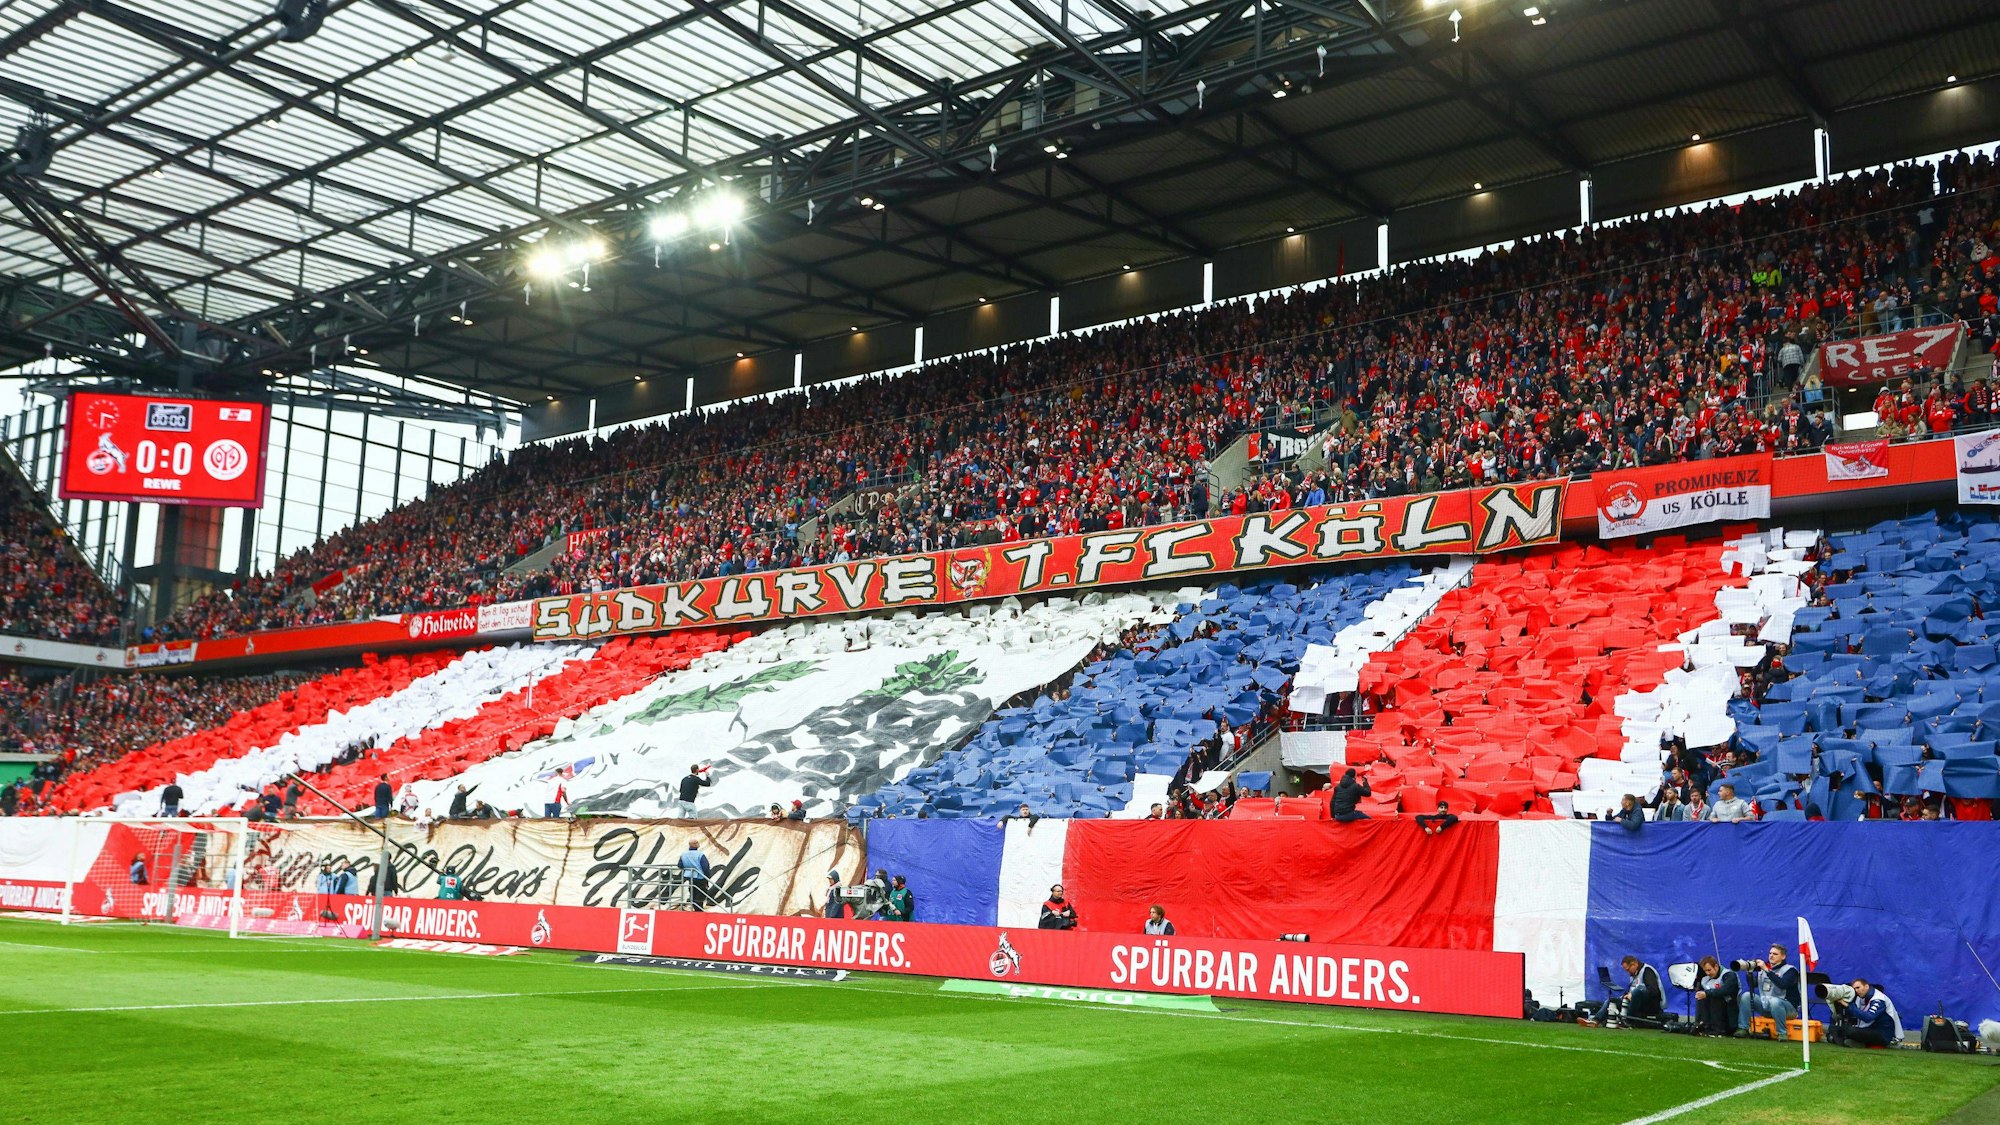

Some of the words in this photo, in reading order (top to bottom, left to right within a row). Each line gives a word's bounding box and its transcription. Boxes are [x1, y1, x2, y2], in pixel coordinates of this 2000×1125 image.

[1848, 364, 1908, 381] CRE
[151, 413, 185, 427] 00:00
[135, 440, 193, 475] 0:0
[143, 477, 181, 490] REWE
[1654, 468, 1759, 496] PROMINENZ
[1662, 502, 1681, 515] US
[1690, 490, 1749, 511] KÖLLE
[535, 557, 938, 638] SÜDKURVE
[1233, 485, 1563, 568] KÖLN
[422, 612, 475, 638] Holweide
[414, 907, 481, 938] ANDERS.
[704, 918, 806, 961] SPÜRBAR
[811, 928, 912, 968] ANDERS.
[1110, 938, 1258, 993] SPÜRBAR
[1269, 953, 1421, 1005] ANDERS.
